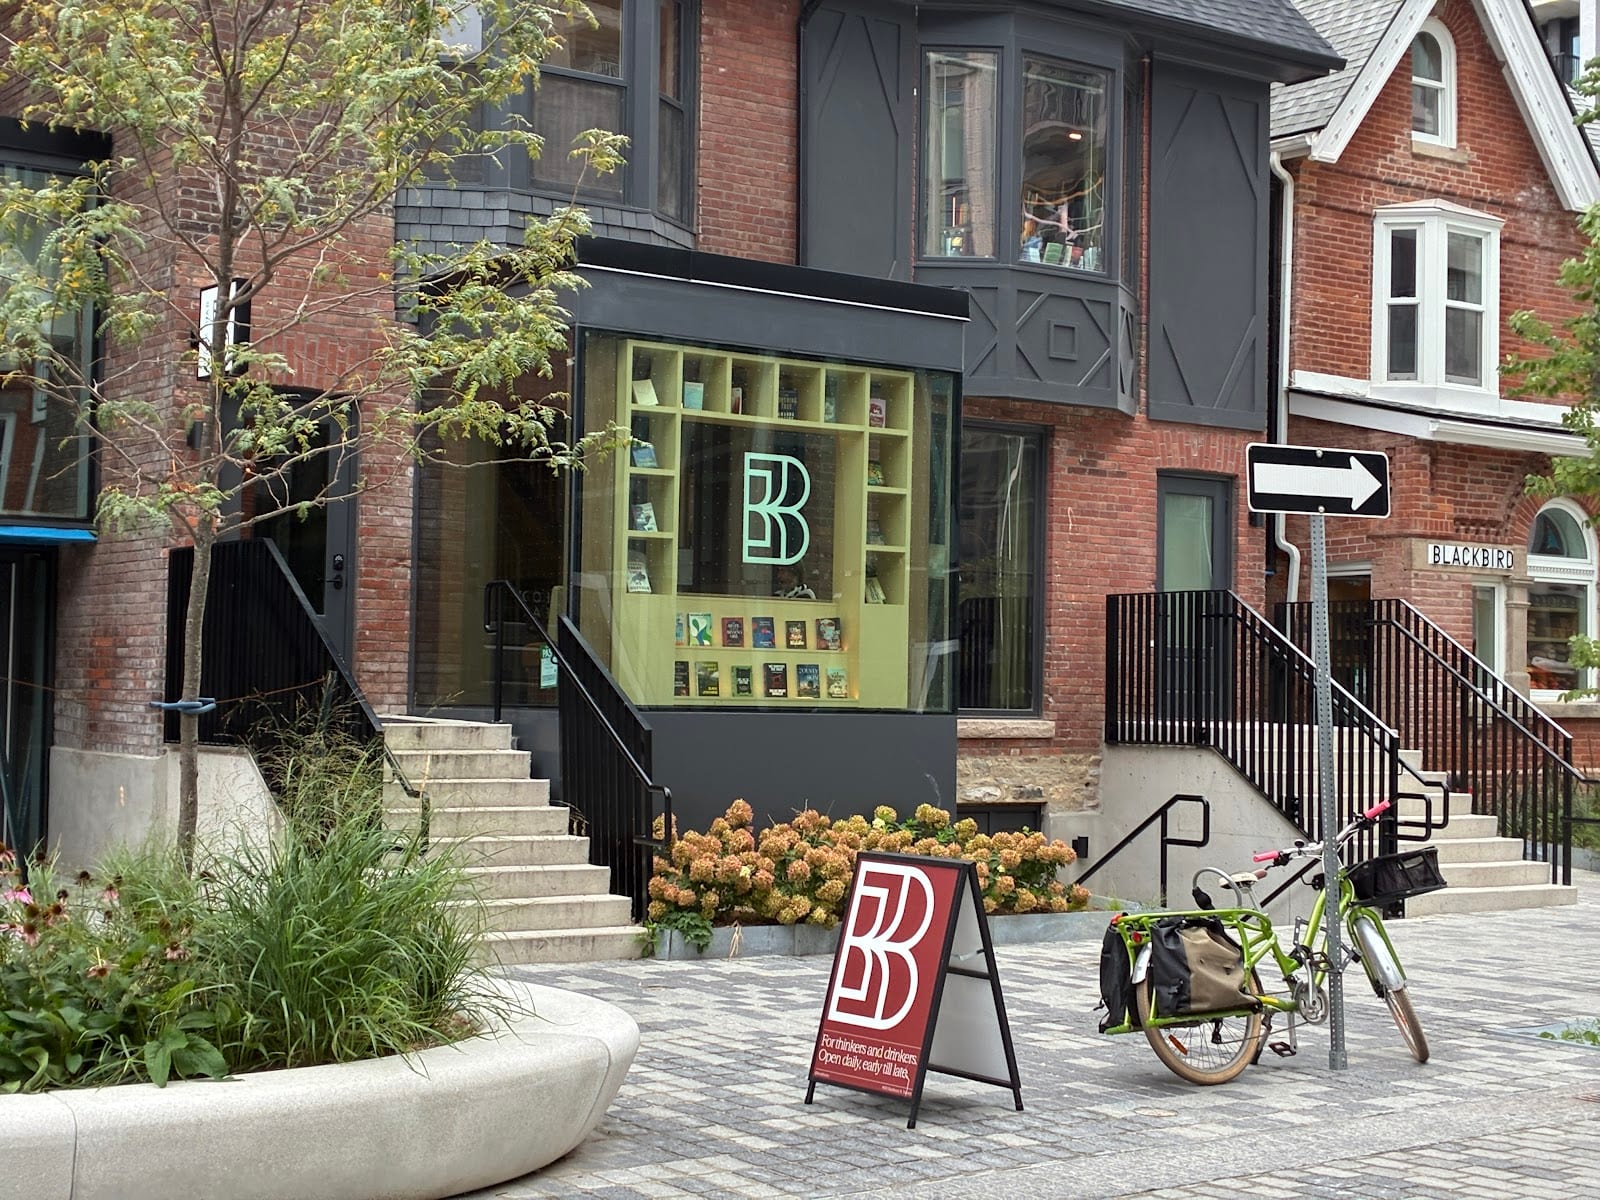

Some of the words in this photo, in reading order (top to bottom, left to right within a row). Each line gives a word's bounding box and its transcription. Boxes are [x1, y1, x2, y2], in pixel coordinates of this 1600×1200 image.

[1433, 545, 1514, 569] BLACKBIRD
[821, 1034, 834, 1048] For
[835, 1037, 867, 1055] thinkers
[867, 1046, 883, 1058] and
[819, 1049, 841, 1064] Open
[862, 1059, 882, 1075] early
[883, 1062, 893, 1075] till
